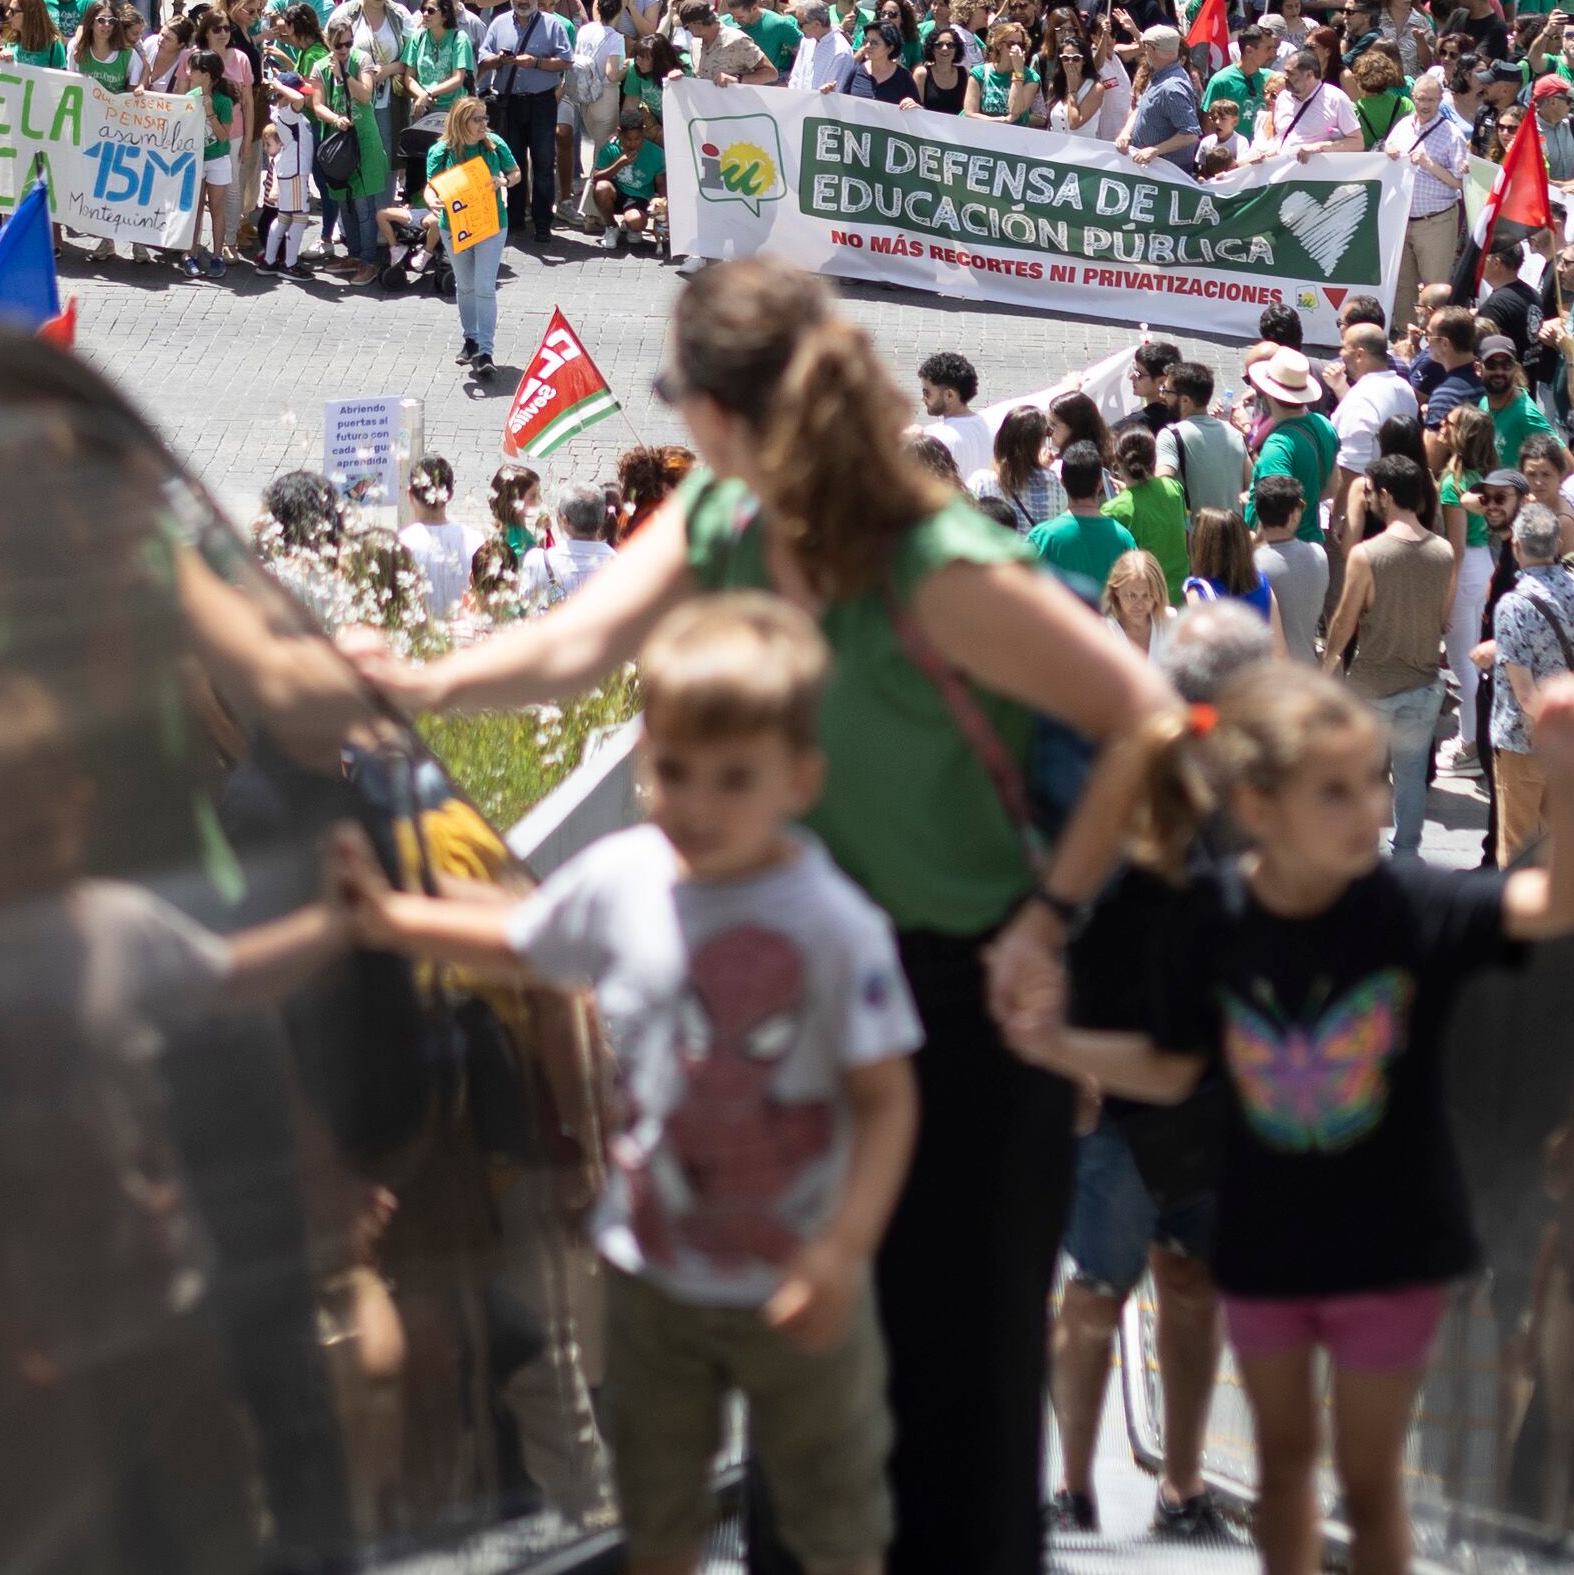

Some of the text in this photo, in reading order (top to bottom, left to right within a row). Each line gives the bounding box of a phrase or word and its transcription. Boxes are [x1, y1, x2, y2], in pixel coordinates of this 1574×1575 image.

[185, 102, 195, 113] A
[98, 121, 199, 153] asamblea
[84, 141, 197, 212] 15M
[816, 125, 1221, 226] EN DEFENSA DE LA
[813, 175, 1275, 265] EDUCACIÓN PÚBLICA
[831, 230, 1283, 306] NO MÁS RECORTES NI PRIVATIZACIONES
[340, 404, 386, 415] Abriendo
[338, 416, 388, 430] puertas al
[336, 431, 389, 441] futuro con
[332, 445, 356, 455] cada
